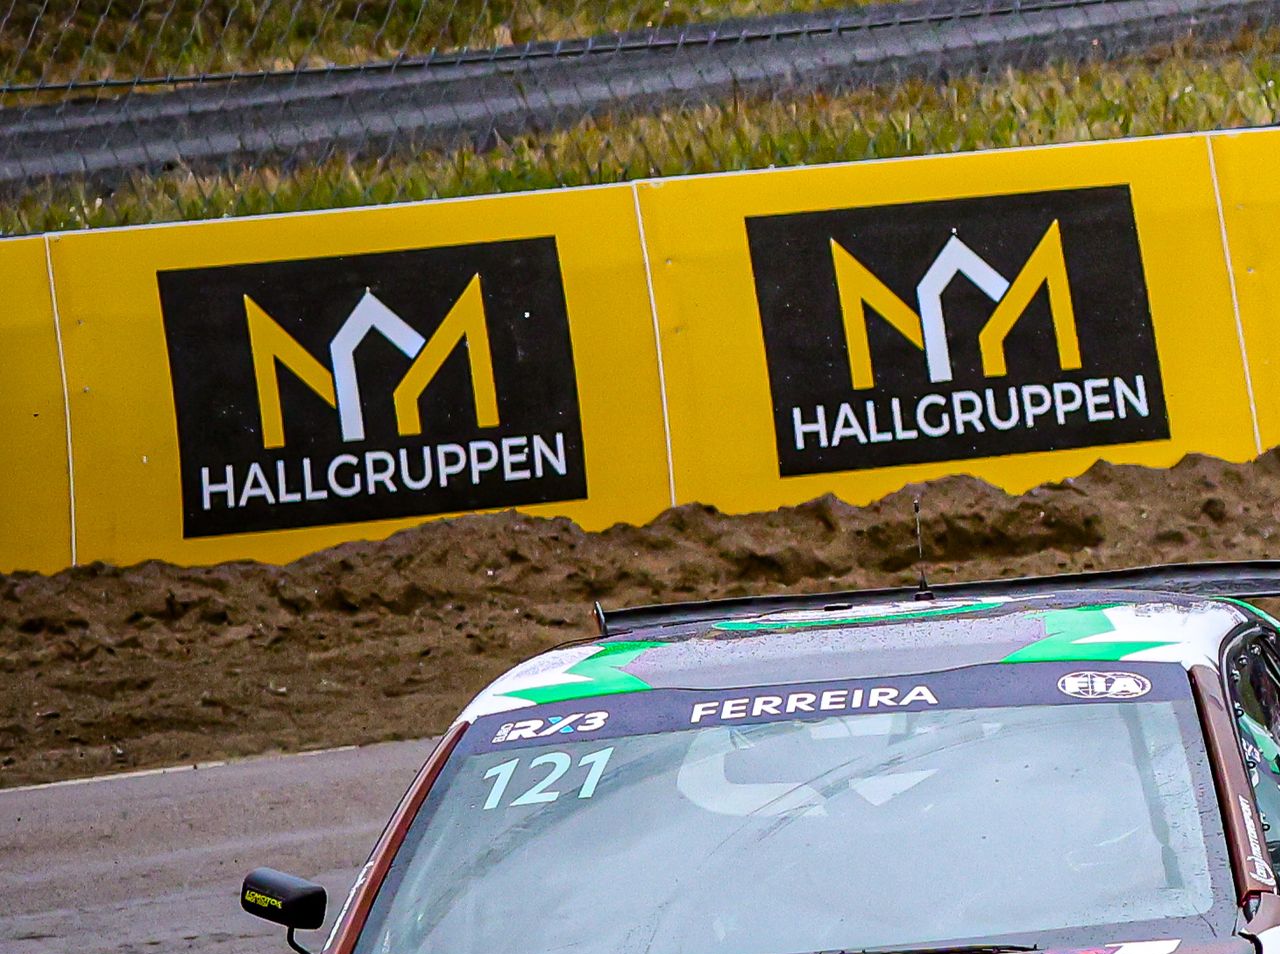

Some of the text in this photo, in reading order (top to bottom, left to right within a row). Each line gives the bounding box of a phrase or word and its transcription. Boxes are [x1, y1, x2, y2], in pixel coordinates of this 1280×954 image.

[792, 374, 1149, 450] HALLGRUPPEN
[200, 432, 568, 510] HALLGRUPPEN
[690, 685, 939, 723] FERREIRA
[482, 747, 614, 809] 121
